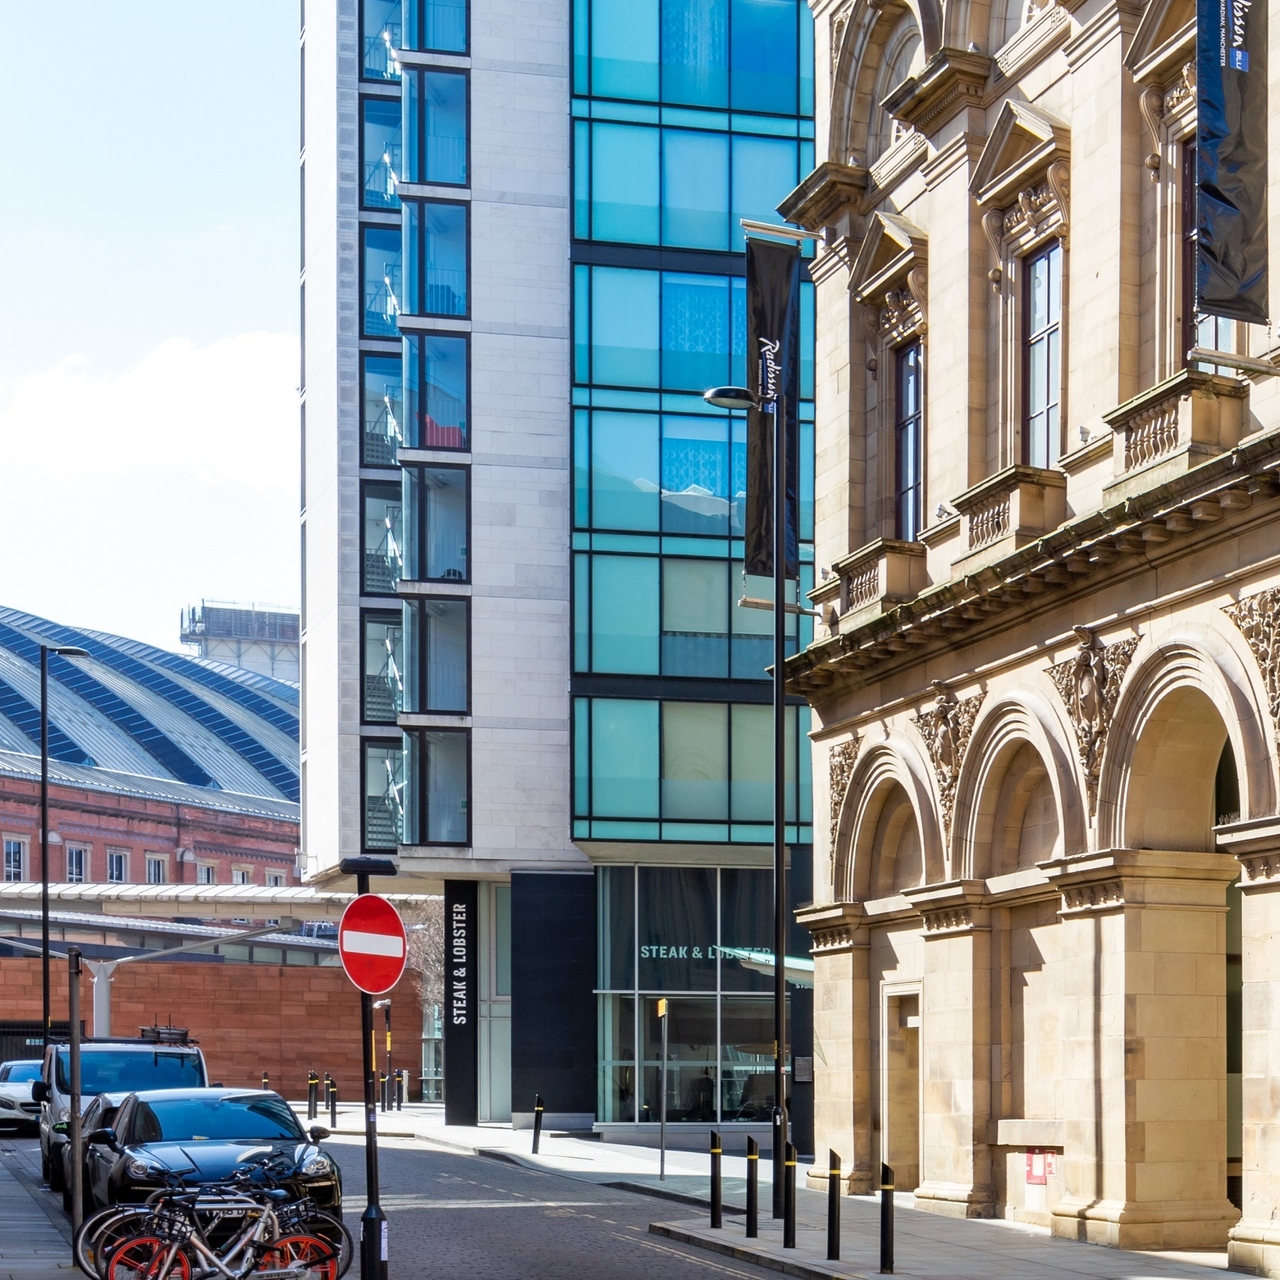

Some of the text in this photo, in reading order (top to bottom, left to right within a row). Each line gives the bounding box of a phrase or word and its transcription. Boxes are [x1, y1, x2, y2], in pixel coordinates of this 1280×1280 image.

[759, 337, 782, 398] Radisson
[453, 904, 467, 1024] STEAK & LOBSTER
[640, 945, 688, 959] STEAK
[692, 947, 703, 959] &
